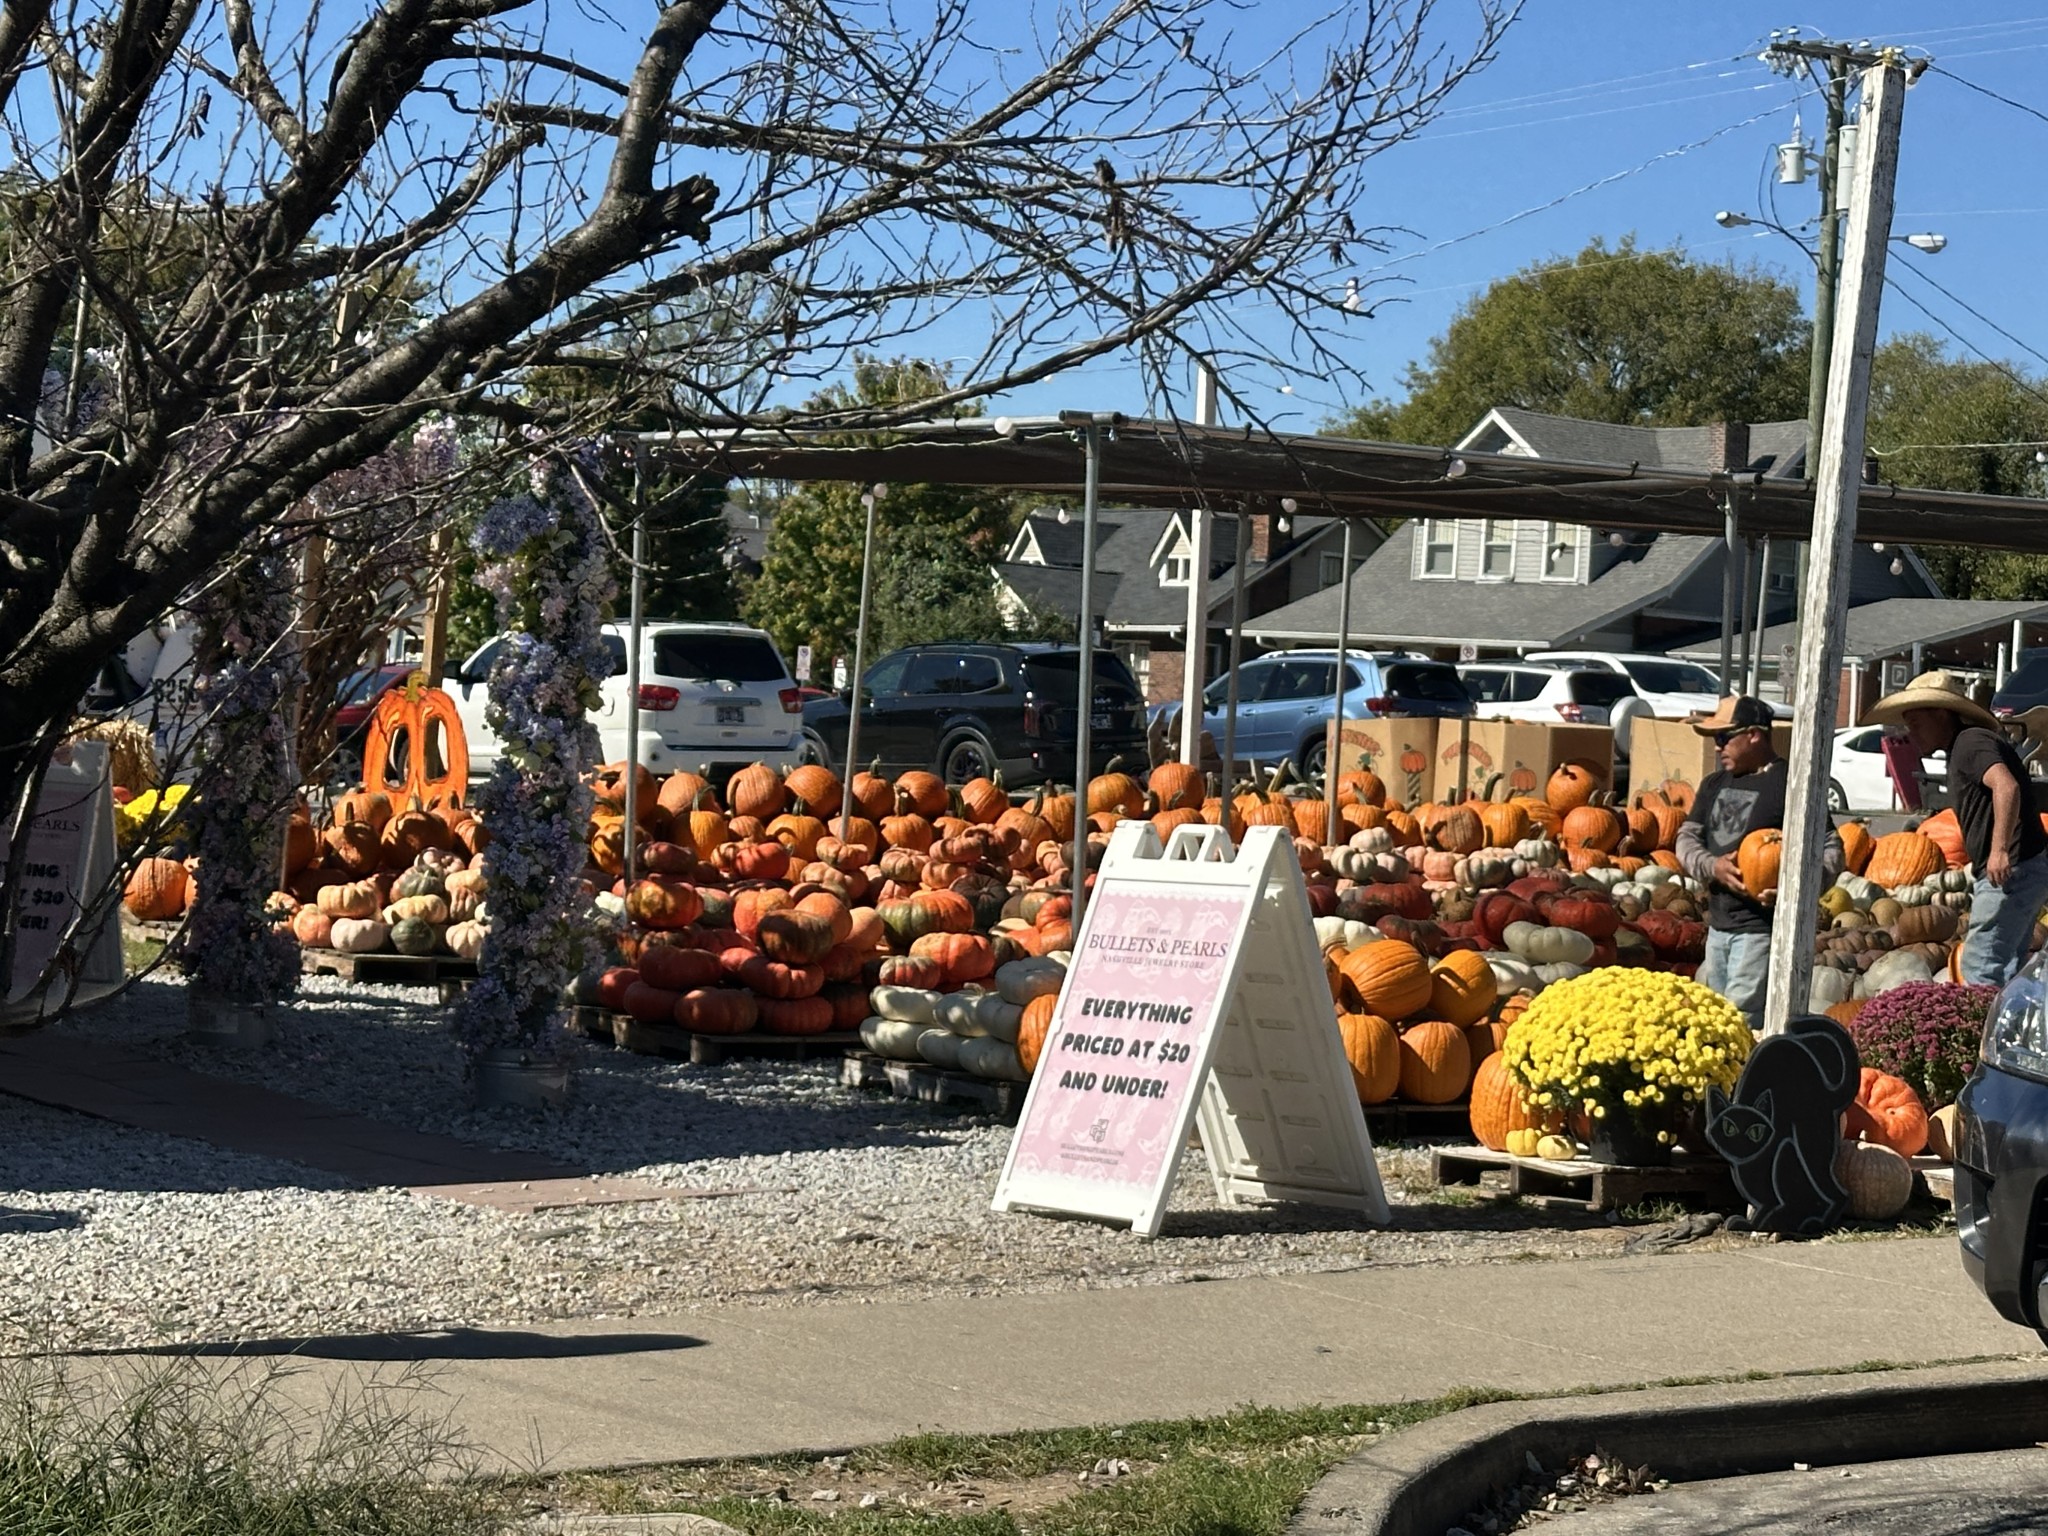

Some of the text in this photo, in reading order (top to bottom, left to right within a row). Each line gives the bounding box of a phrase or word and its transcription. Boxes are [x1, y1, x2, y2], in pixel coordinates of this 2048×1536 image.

[32, 888, 64, 905] $20
[1088, 934, 1229, 958] BULLETS & PEARLS
[1081, 997, 1193, 1025] EVERYTHING
[1061, 1032, 1191, 1064] PRICED AT $20
[1059, 1070, 1169, 1100] AND UNDER!
